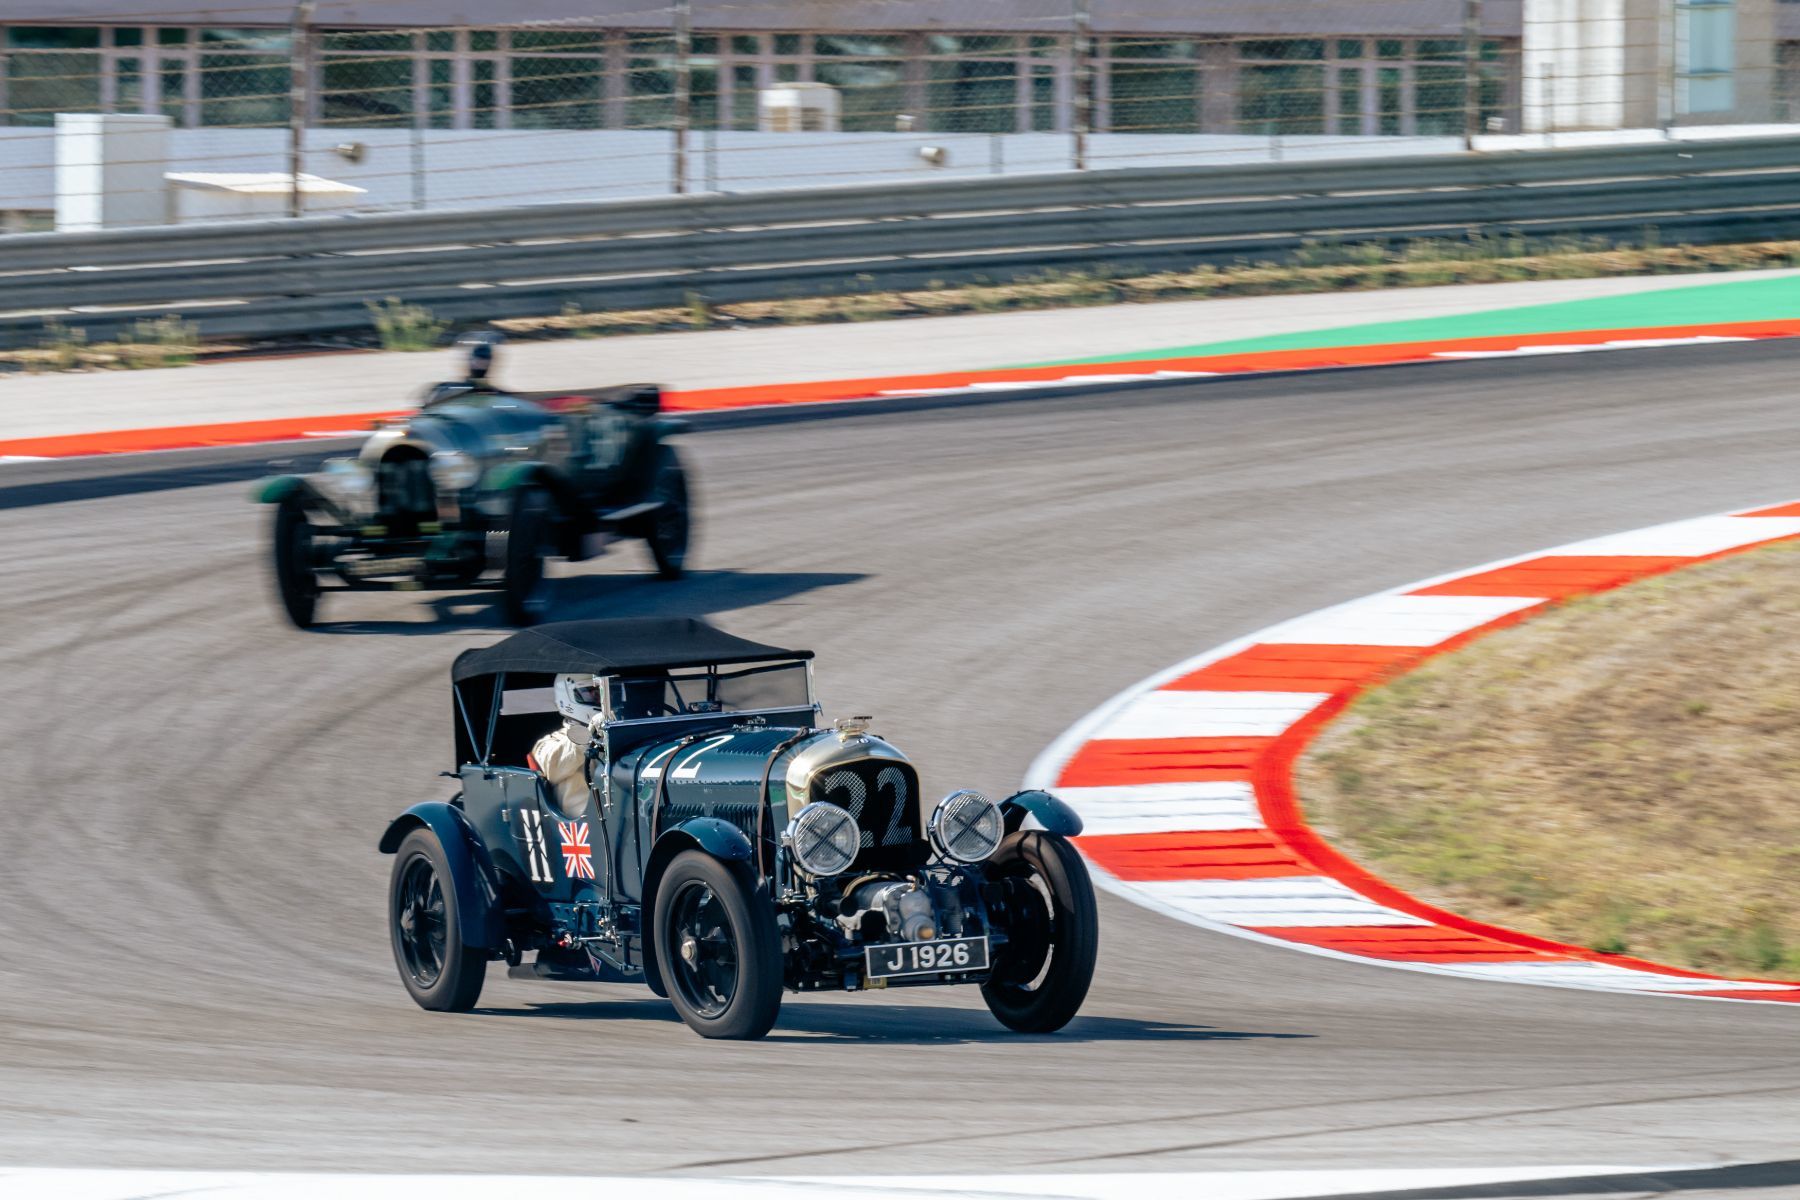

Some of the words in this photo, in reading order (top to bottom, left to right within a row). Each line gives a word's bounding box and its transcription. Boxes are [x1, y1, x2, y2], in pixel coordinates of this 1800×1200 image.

[824, 766, 913, 849] 22
[887, 947, 904, 971] J
[910, 942, 970, 970] 1926
